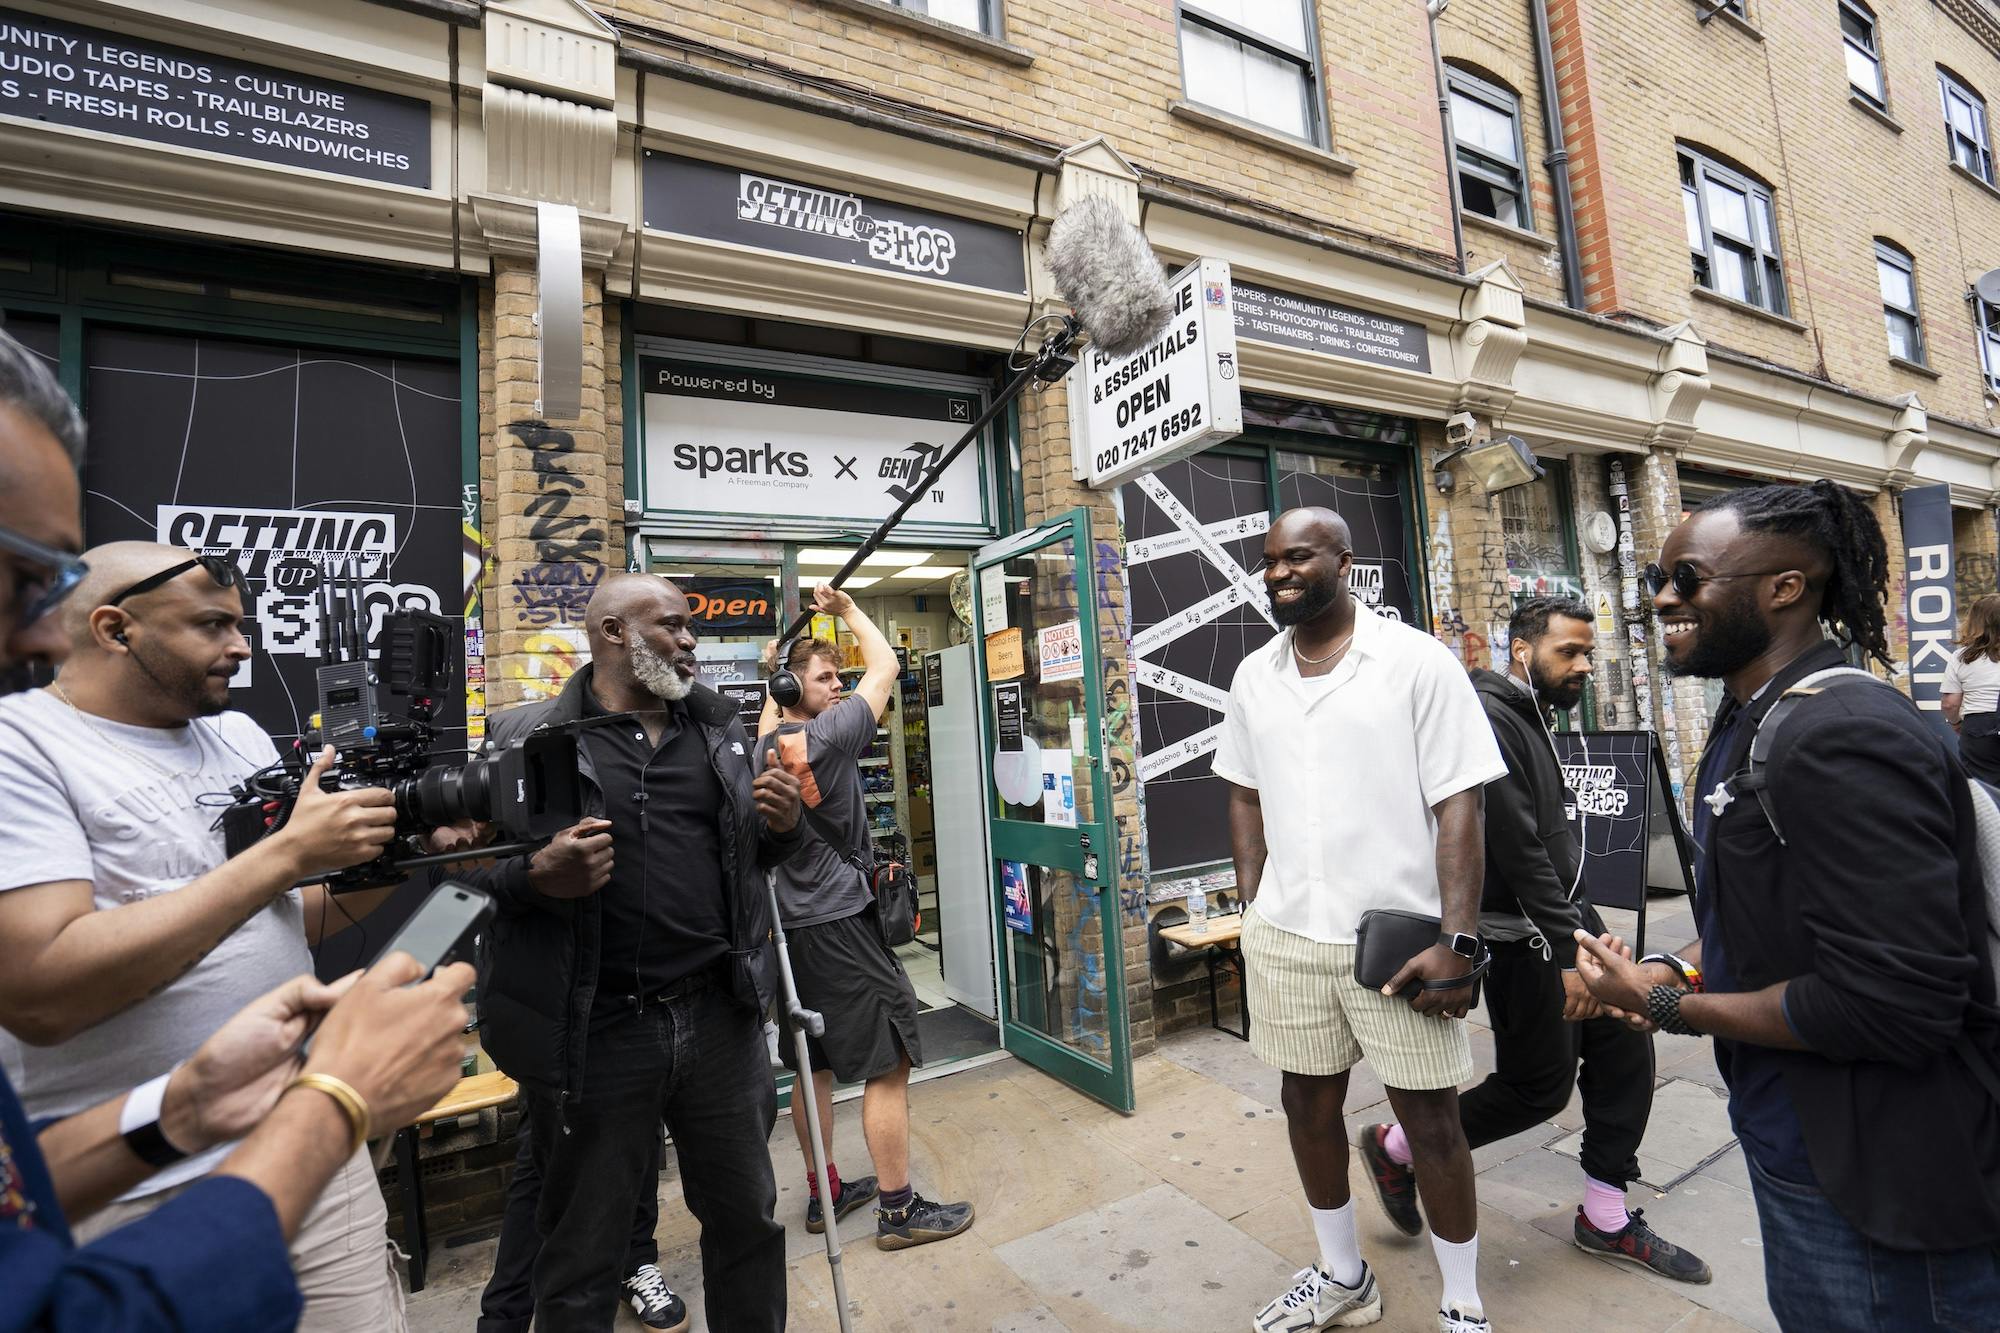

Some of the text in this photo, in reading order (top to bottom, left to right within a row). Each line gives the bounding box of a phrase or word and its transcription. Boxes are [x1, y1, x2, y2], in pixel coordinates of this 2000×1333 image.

[87, 42, 212, 84] LEGENDS
[234, 75, 345, 112] CULTURE
[83, 68, 170, 101] TAPES
[193, 90, 370, 140] TRAILBLAZERS
[47, 88, 138, 121] FRESH
[147, 107, 230, 138] ROLLS
[252, 127, 411, 171] SANDWICHES
[740, 179, 954, 272] SETTING UP SHOP
[1232, 285, 1405, 336] PAPERS COMMUNITY LEGENDS CULTURE
[1270, 309, 1339, 334] PHOTOCOPYING
[1344, 326, 1400, 347] TRAILBLAZERS
[1251, 319, 1314, 342] TASTEMAKERS
[1320, 335, 1351, 348] DRINKS
[1356, 342, 1420, 364] CONFECTIONERY
[1094, 320, 1198, 405] & ESSENTIALS
[658, 369, 776, 399] Powered by
[1116, 373, 1171, 429] OPEN
[1097, 402, 1202, 473] 020 7247 6592
[673, 442, 809, 479] sparks
[878, 457, 912, 479] GEN
[728, 478, 810, 490] A Freeman Company
[931, 490, 944, 503] TV
[168, 511, 387, 578] SETTING
[1152, 537, 1191, 551] Tastemakers
[1211, 529, 1229, 538] sparks
[1185, 520, 1227, 565] #SettingUpShop
[277, 566, 317, 587] UP
[684, 592, 768, 620] Open
[1160, 621, 1184, 637] legends
[1203, 603, 1220, 615] sparks
[1007, 634, 1020, 644] Free
[1044, 626, 1075, 642] NOTICE
[700, 662, 735, 674] NESCAFÉ
[997, 650, 1014, 661] Beers
[1188, 688, 1222, 705] Trailblazers
[1200, 735, 1218, 747] sparks
